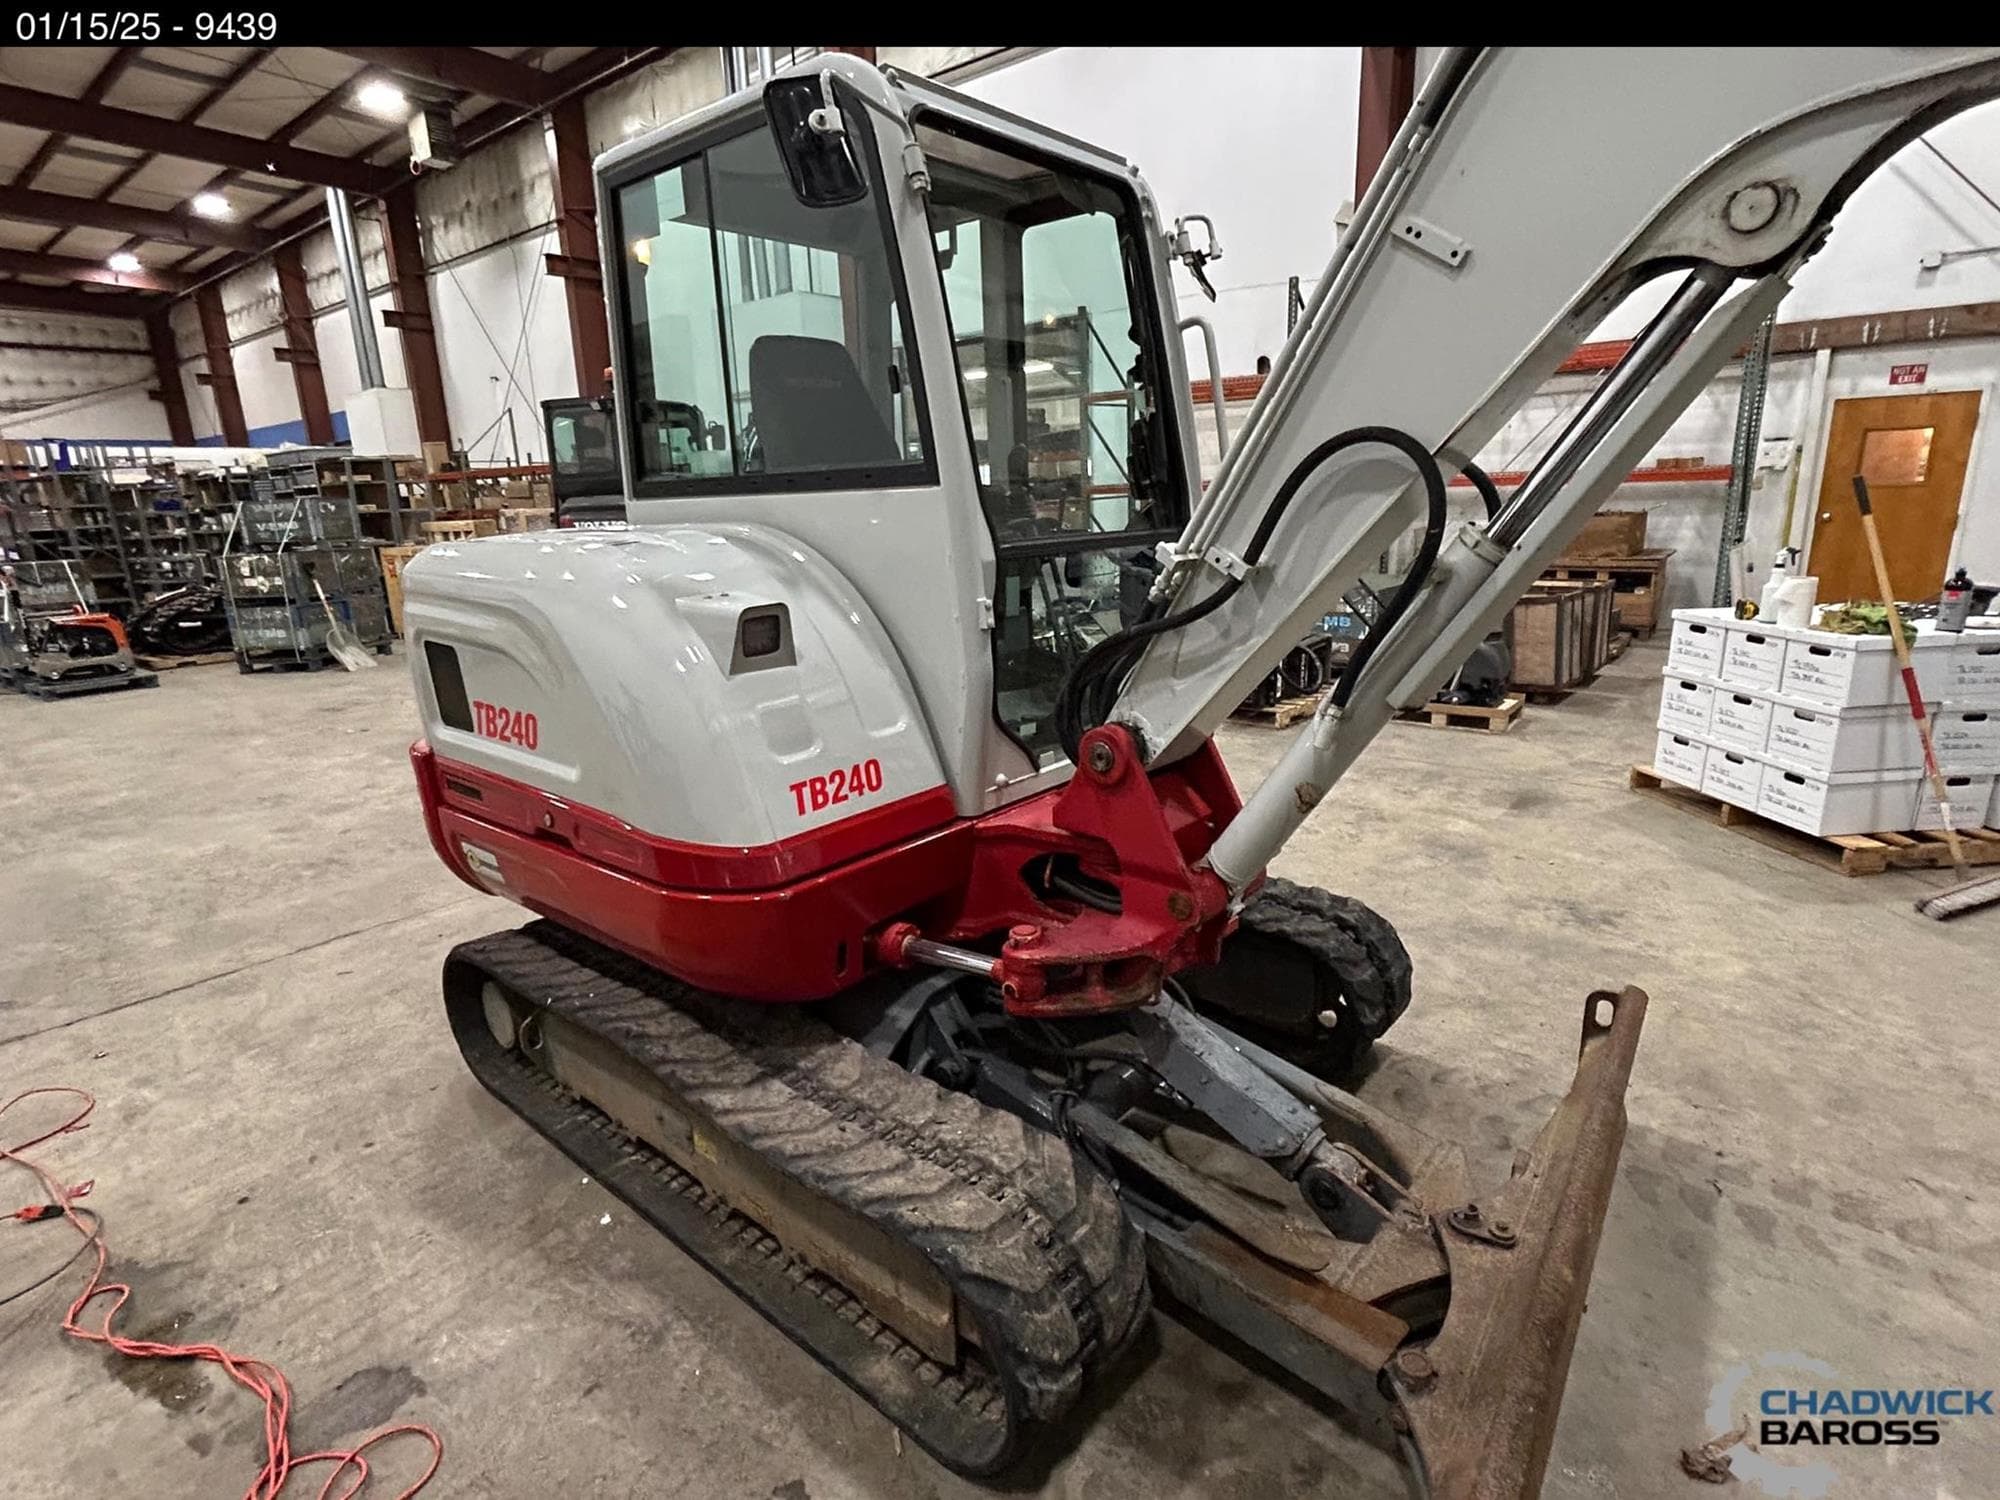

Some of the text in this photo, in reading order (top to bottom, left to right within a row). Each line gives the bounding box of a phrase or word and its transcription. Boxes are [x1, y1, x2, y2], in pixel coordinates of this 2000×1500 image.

[1892, 367, 1910, 375] NOT
[1898, 375, 1918, 383] EXIT
[473, 700, 538, 750] TB240
[788, 758, 882, 816] TB240
